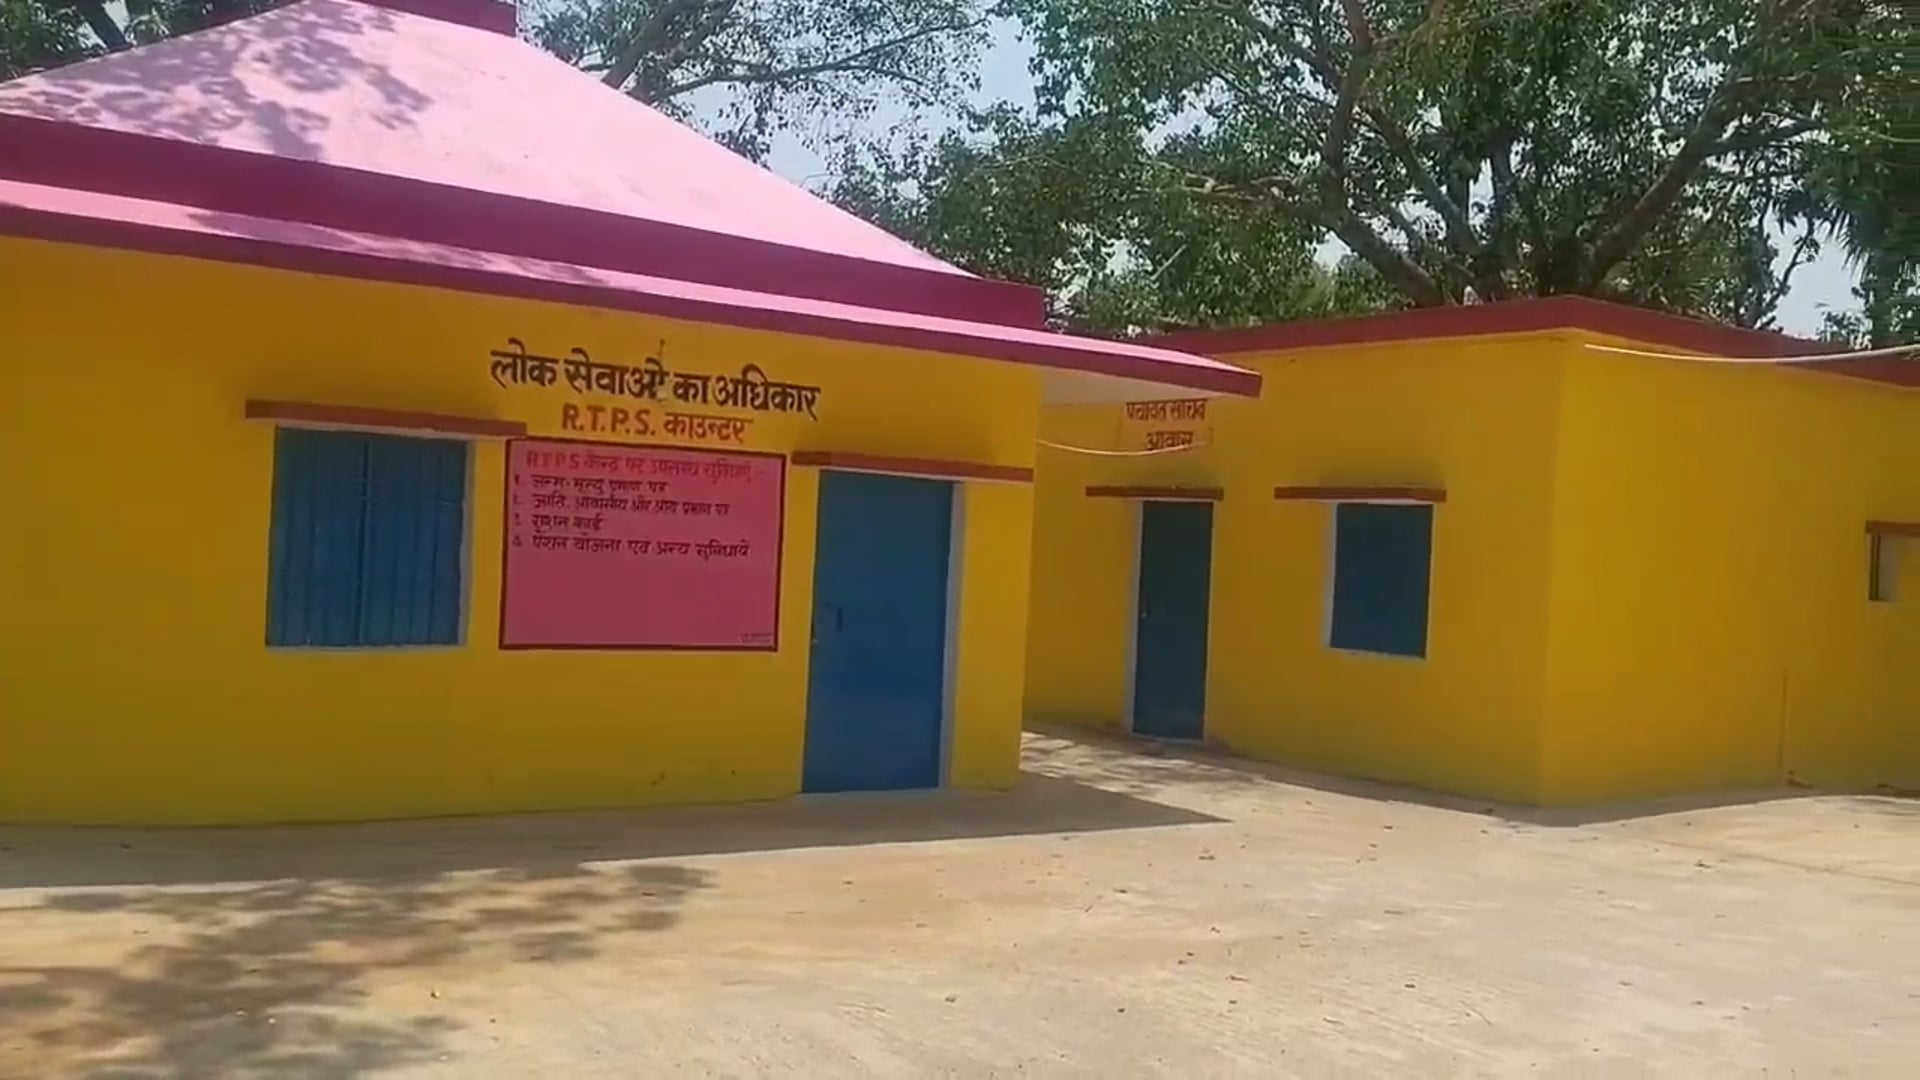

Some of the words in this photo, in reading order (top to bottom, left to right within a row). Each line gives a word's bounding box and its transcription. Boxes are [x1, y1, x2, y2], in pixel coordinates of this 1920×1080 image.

[490, 338, 559, 388] लोक
[673, 371, 710, 405] का
[712, 364, 821, 421] अधिकार
[562, 402, 656, 437] R.T.P.S.
[663, 412, 754, 444] काउन्टर
[626, 456, 646, 474] पर
[531, 513, 569, 528] राशन
